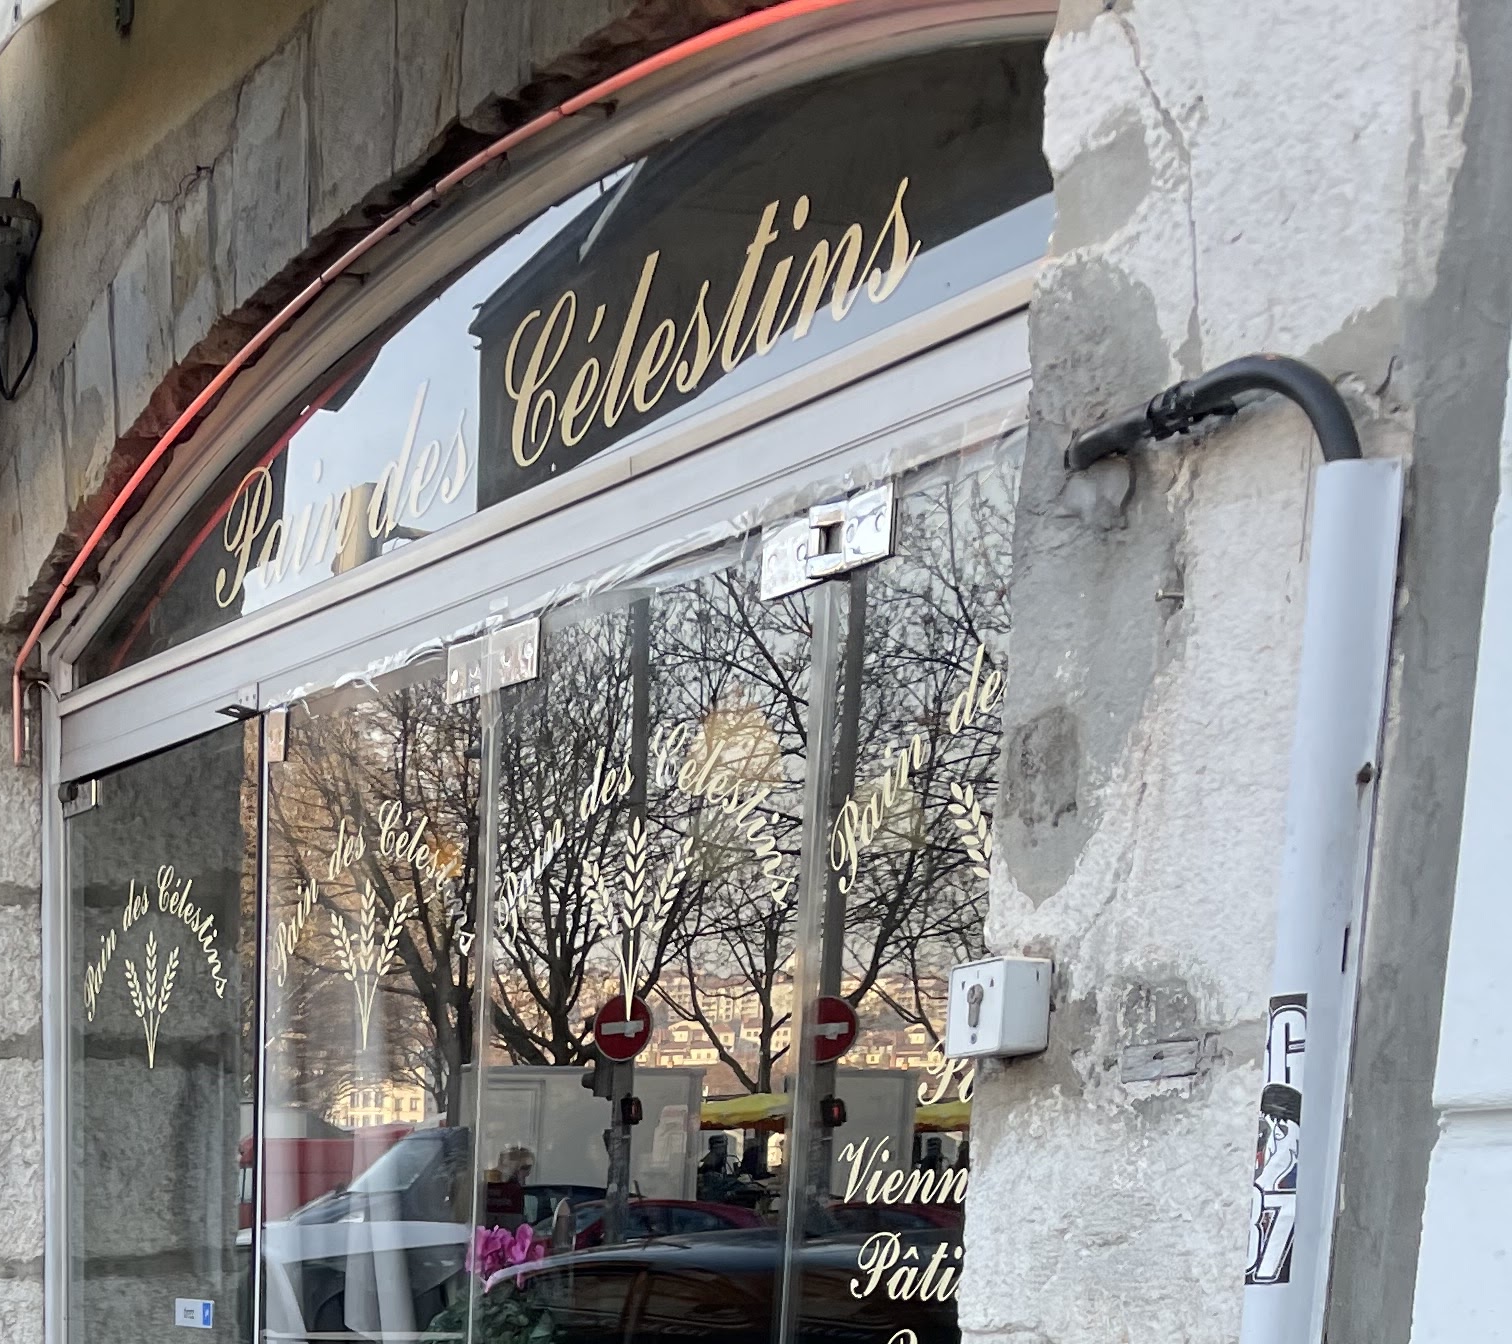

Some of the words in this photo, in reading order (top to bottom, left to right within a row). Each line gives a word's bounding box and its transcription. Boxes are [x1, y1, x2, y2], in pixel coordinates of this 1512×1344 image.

[215, 457, 358, 608] Pain
[366, 377, 475, 539] des
[505, 176, 922, 469] Célestins
[580, 747, 635, 821] des
[830, 733, 929, 894] Pain
[949, 643, 1008, 734] de
[83, 928, 117, 1022] Pain
[123, 878, 150, 932] des
[157, 864, 228, 999] Célestins
[272, 878, 320, 988] Pain
[328, 817, 367, 881] des
